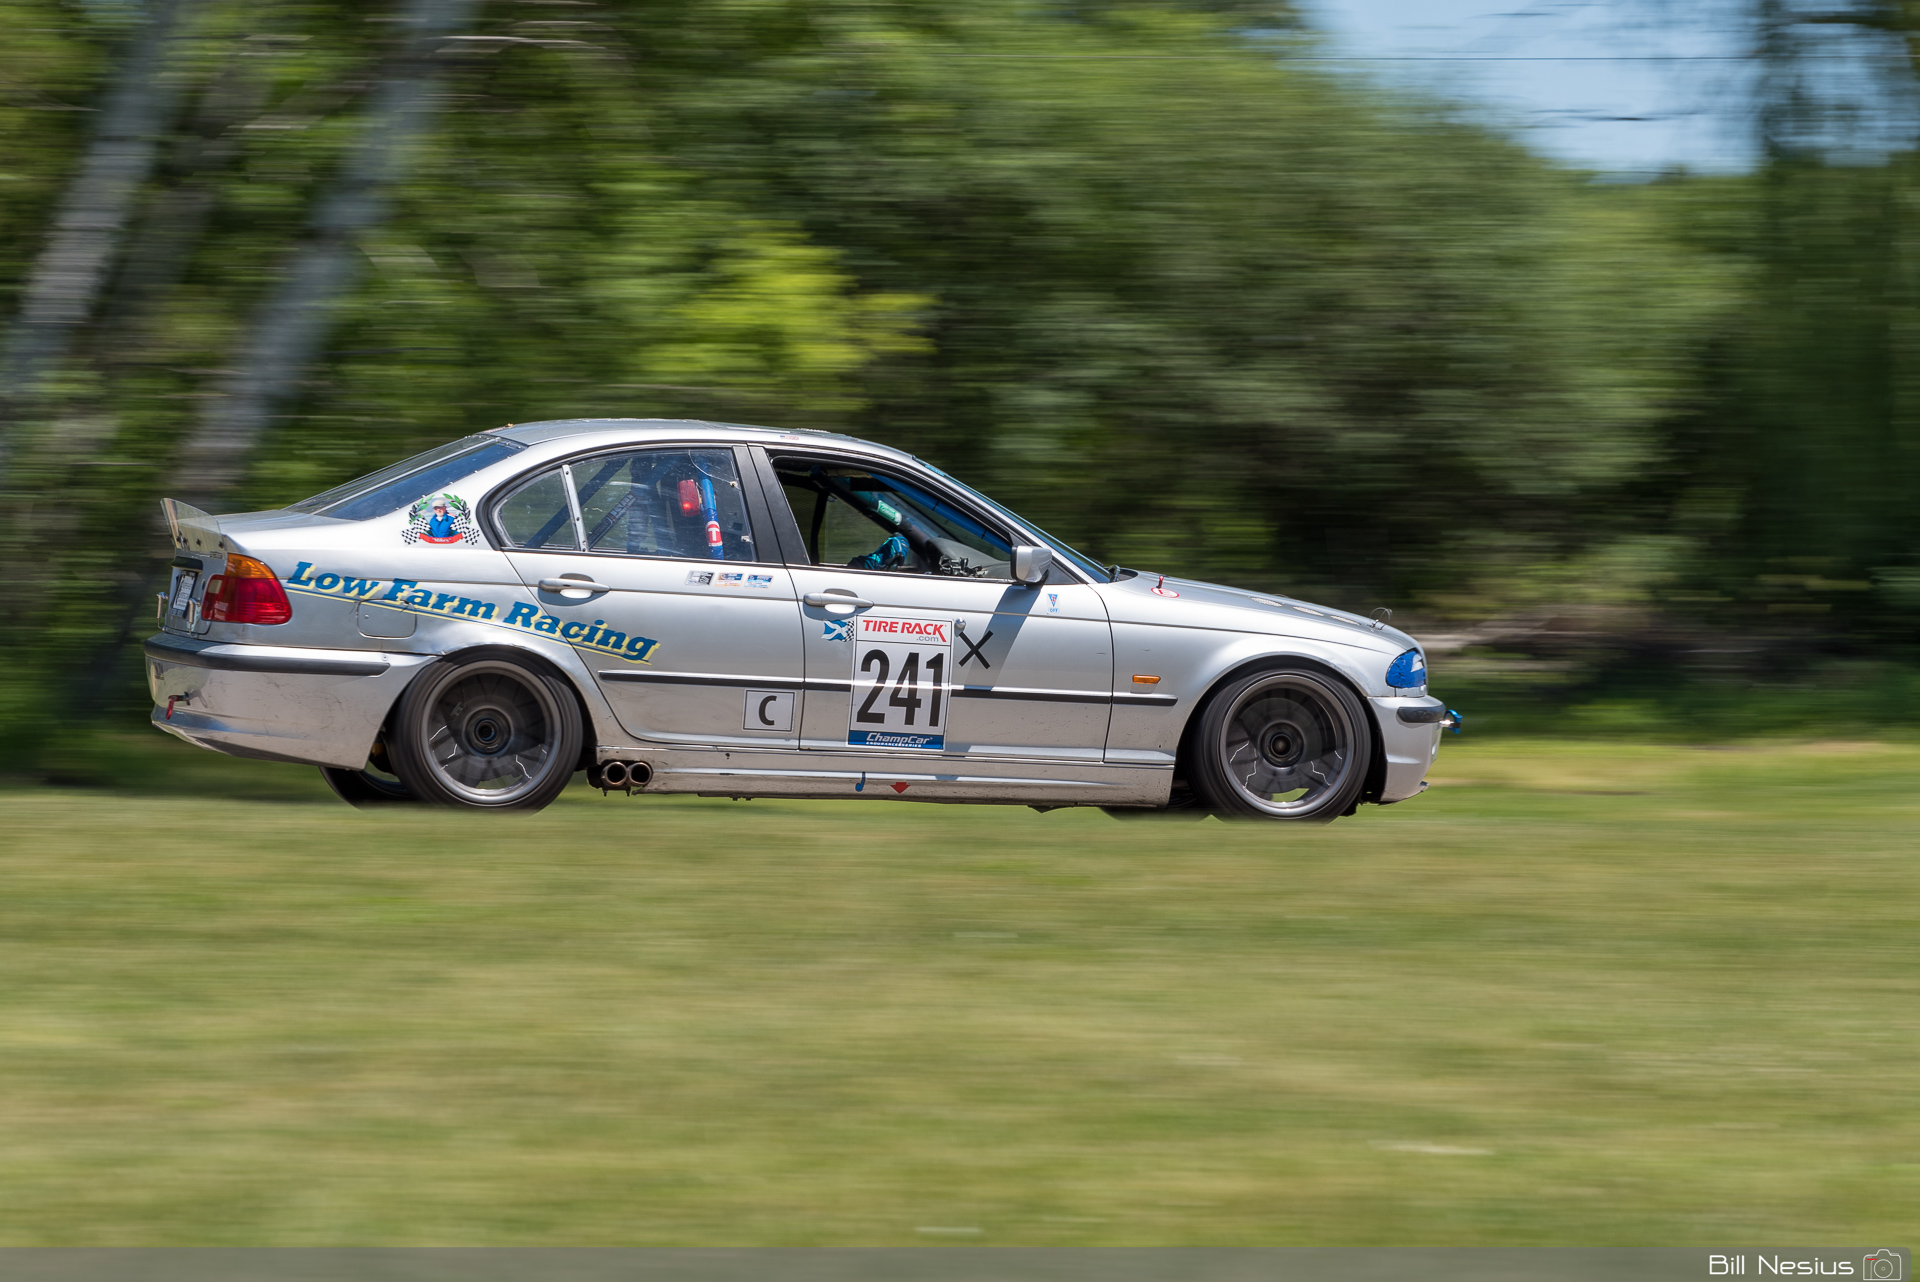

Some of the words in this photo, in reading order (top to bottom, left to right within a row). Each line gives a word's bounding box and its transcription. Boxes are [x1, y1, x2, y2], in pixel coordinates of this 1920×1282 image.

[707, 527, 720, 542] T
[286, 561, 384, 597] Low
[381, 578, 500, 622] Farm
[503, 601, 661, 665] Racing
[862, 619, 899, 634] TIRE
[900, 622, 947, 643] RACK
[916, 634, 939, 642] .com
[856, 648, 944, 727] 241
[758, 695, 777, 726] C
[866, 732, 930, 744] ChampCar
